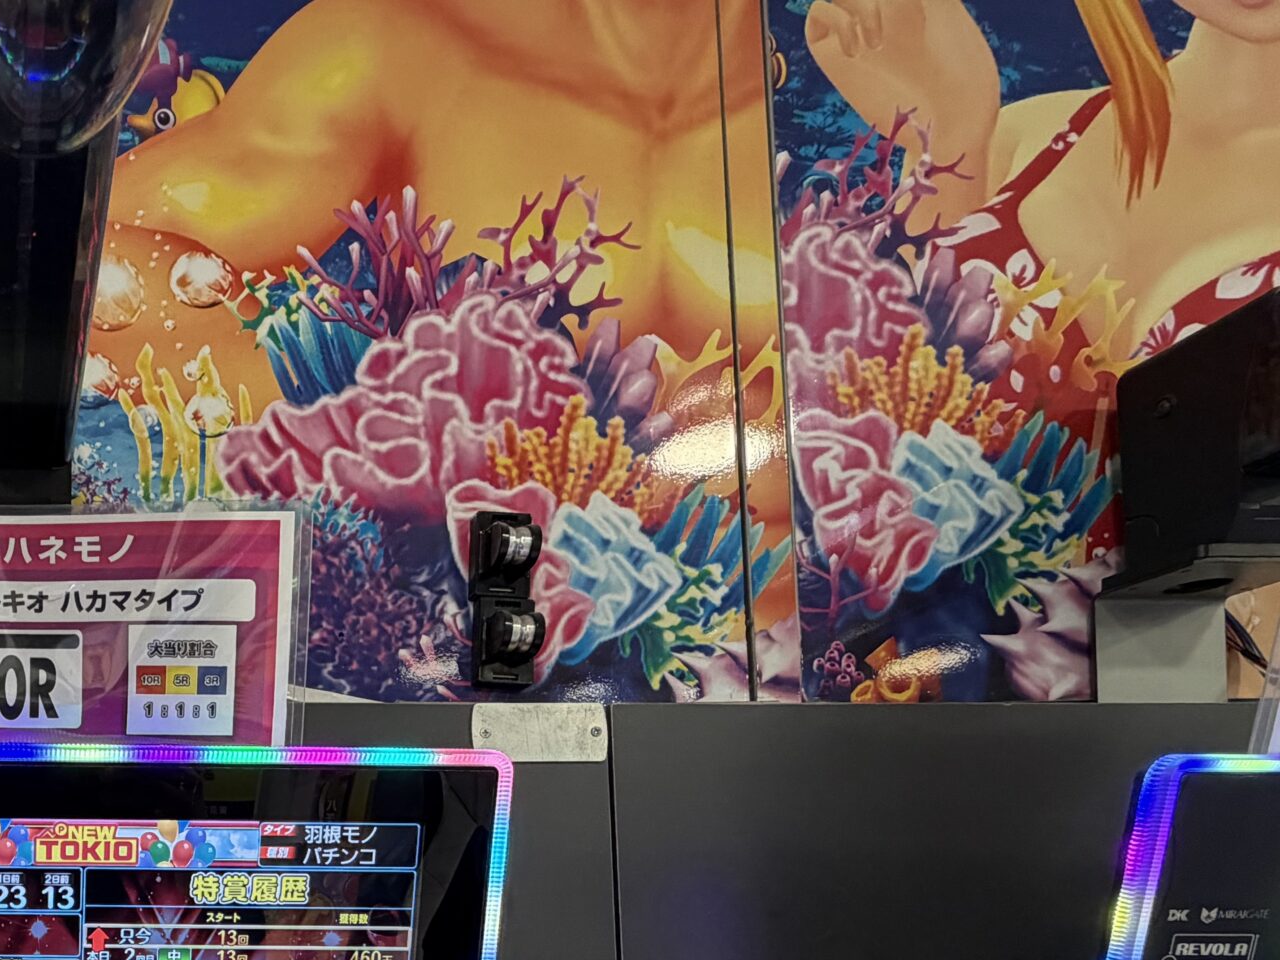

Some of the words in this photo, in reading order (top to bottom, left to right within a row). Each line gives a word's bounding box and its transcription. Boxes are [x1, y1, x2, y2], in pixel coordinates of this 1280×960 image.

[3, 535, 135, 564] ハネモノ
[59, 588, 204, 614] ハカマタイプ
[147, 639, 218, 659] 大当り割合
[141, 674, 161, 686] 10R
[173, 674, 190, 687] 5R
[204, 675, 220, 686] 3R
[68, 826, 117, 840] NEW
[263, 824, 295, 835] タイプ
[304, 826, 378, 845] 羽根モノ
[38, 840, 134, 861] TOKIO
[303, 847, 377, 866] パチンコ
[45, 874, 70, 885] 2日前
[191, 873, 310, 904] 特賞履歴
[42, 886, 75, 910] 13
[206, 912, 241, 923] スタート
[339, 913, 369, 925] 獲得数
[120, 927, 152, 945] 只今
[217, 930, 249, 945] 13回
[1175, 942, 1248, 956] REVOLA
